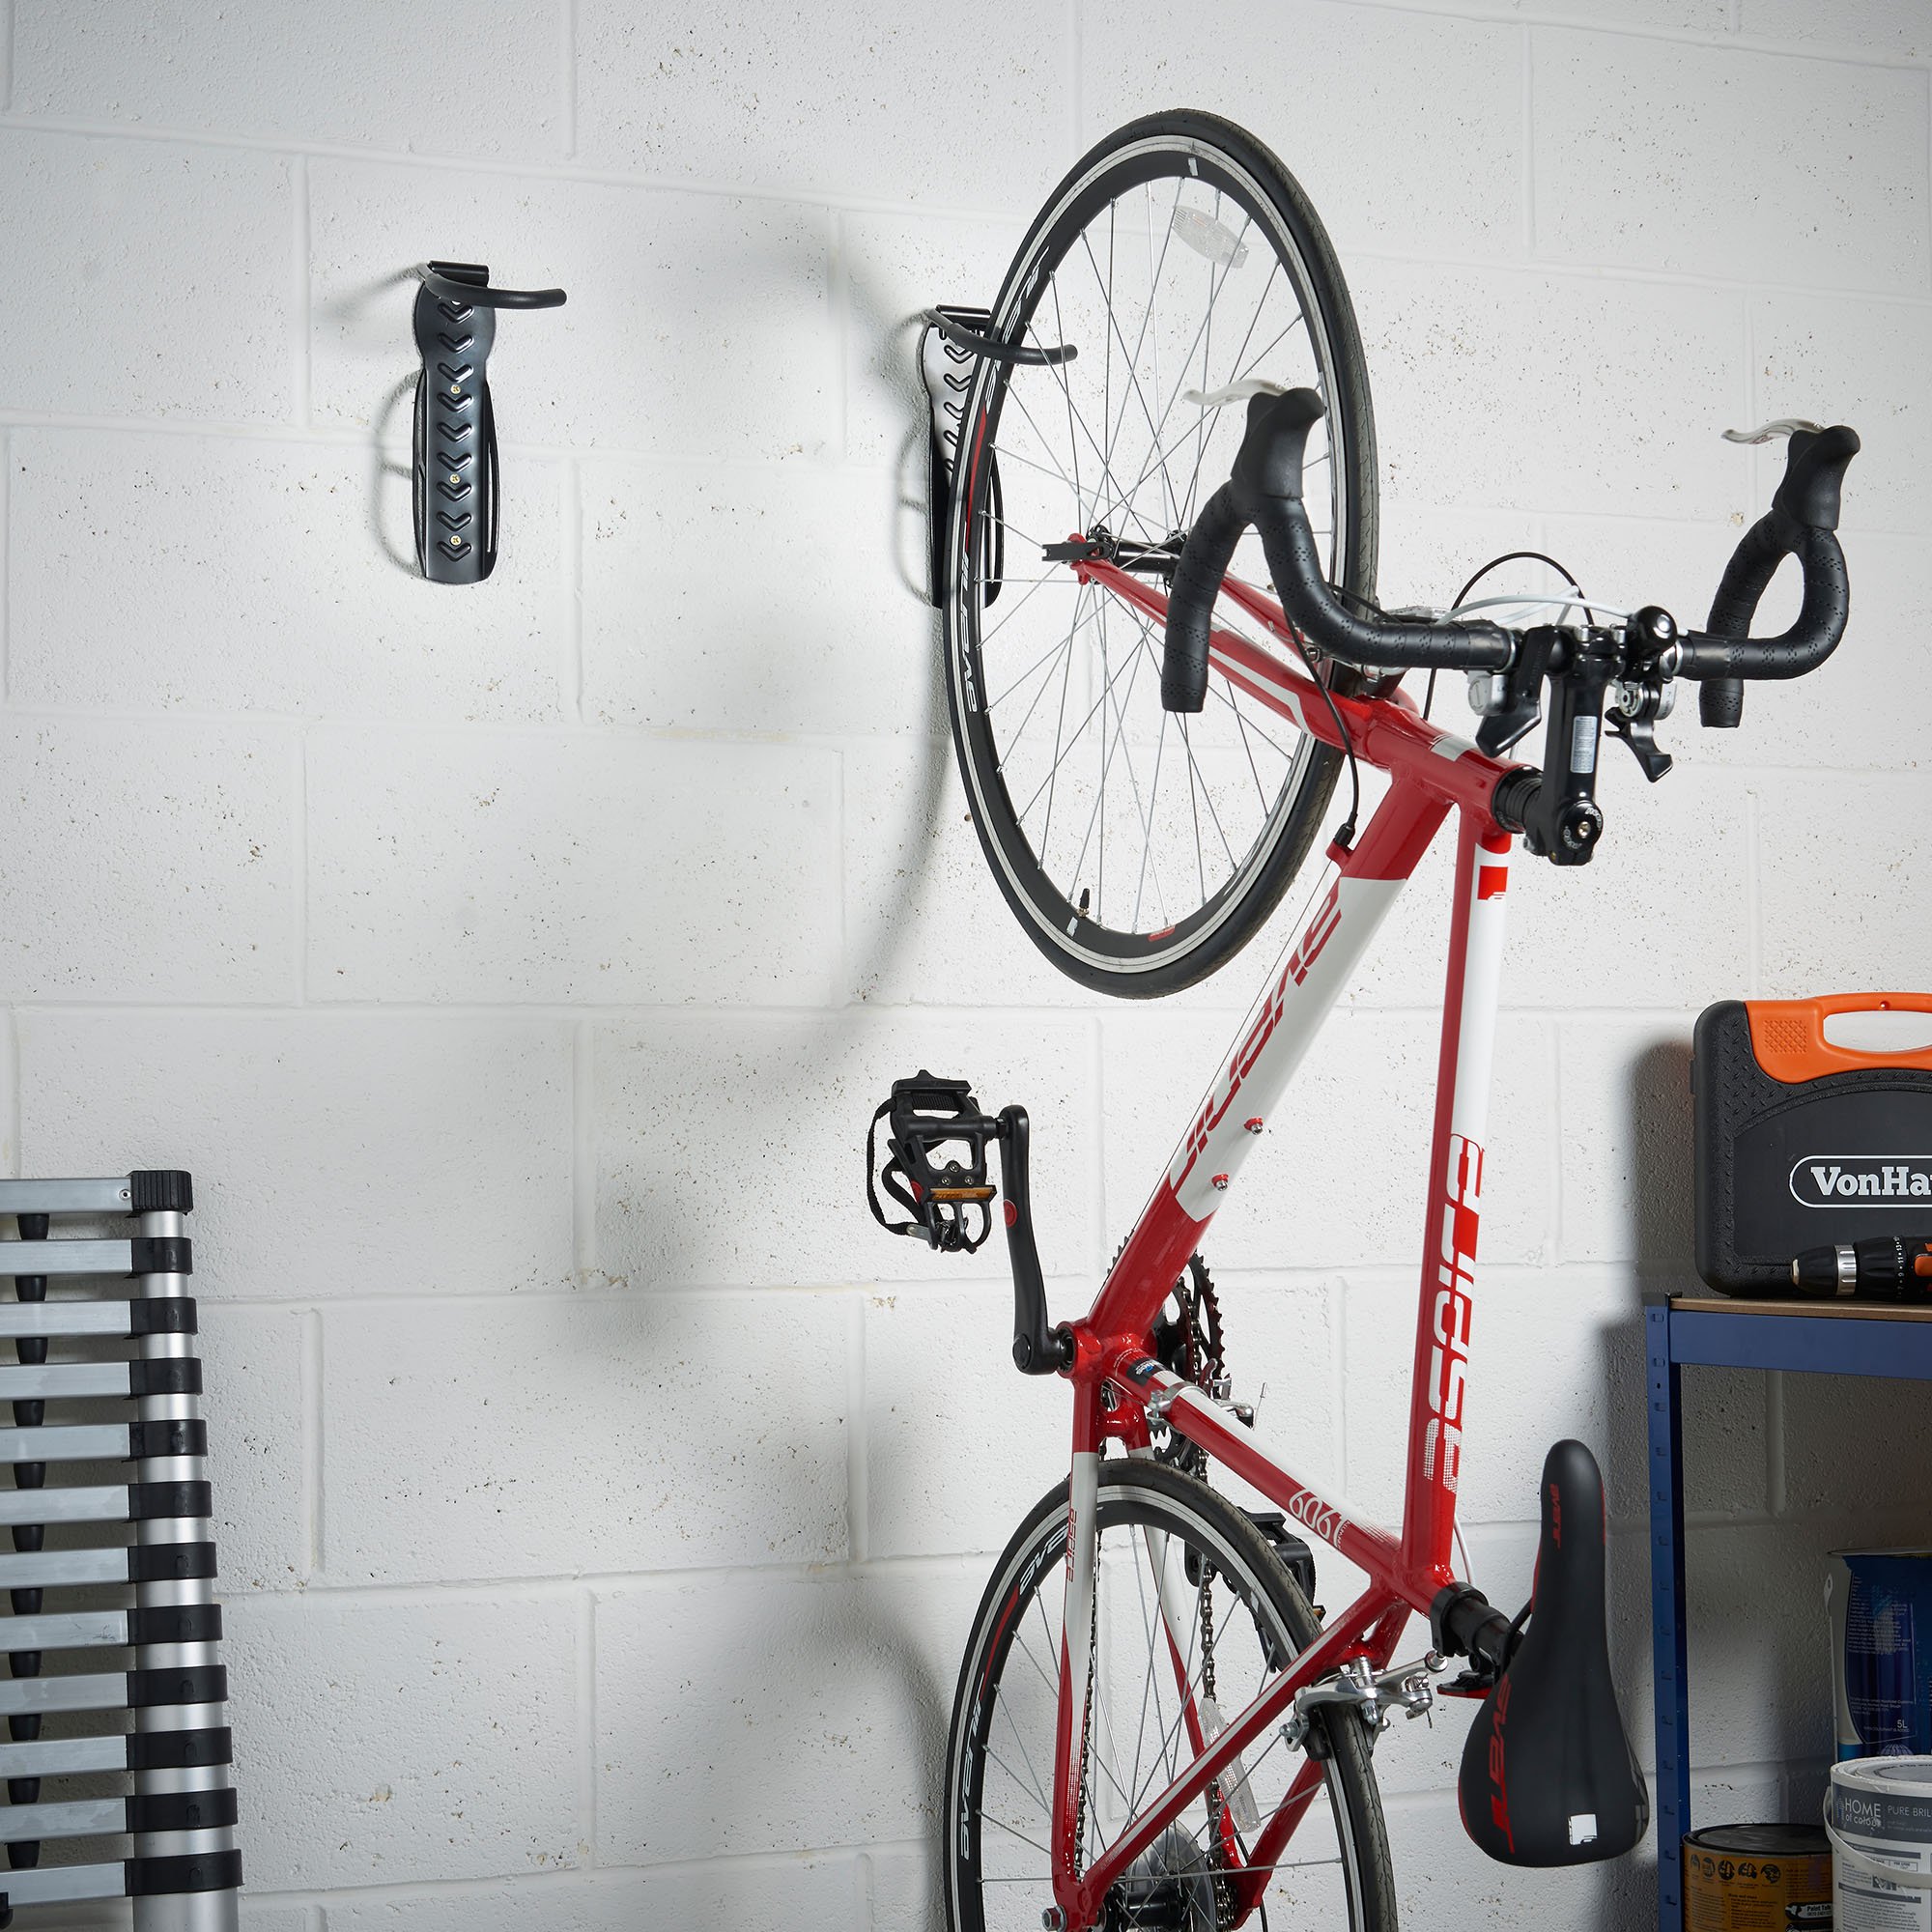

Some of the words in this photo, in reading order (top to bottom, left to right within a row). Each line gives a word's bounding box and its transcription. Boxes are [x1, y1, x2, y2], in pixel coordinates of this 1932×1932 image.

[1810, 1166, 1932, 1196] VonHa
[1845, 1797, 1882, 1818] HOME
[1887, 1804, 1910, 1816] PURE
[1845, 1813, 1853, 1823] of
